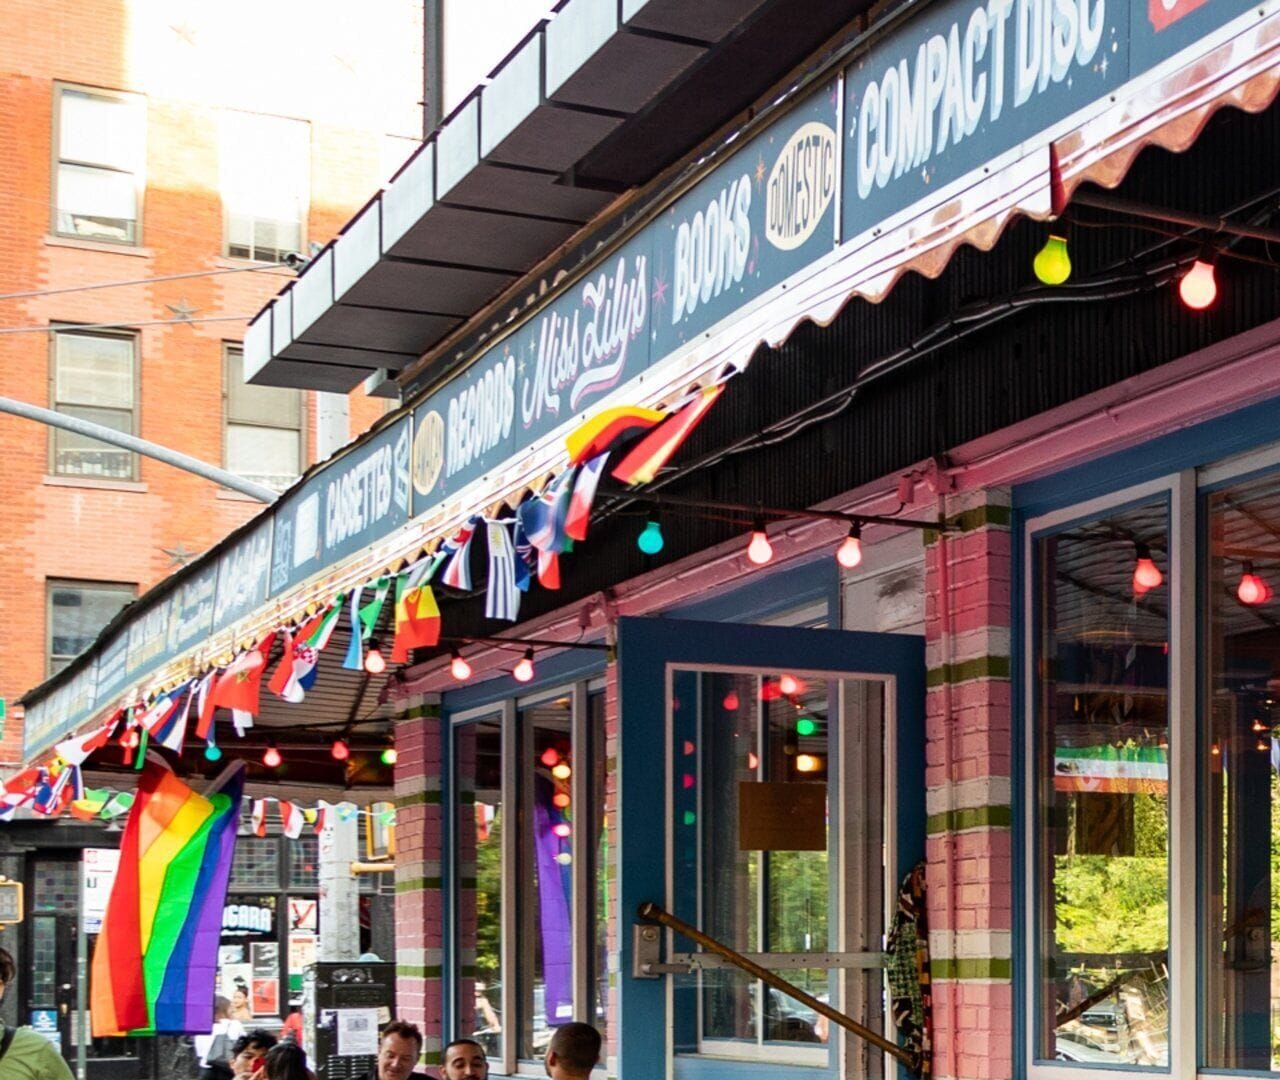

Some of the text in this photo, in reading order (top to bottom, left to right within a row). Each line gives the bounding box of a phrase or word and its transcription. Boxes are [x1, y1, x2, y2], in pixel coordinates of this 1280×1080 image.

[856, 0, 1106, 200] COMPACT DISC
[672, 173, 752, 324] BOOKS
[768, 134, 834, 241] DOMESTIC
[522, 254, 648, 429] Miss Lily's
[446, 355, 515, 478] RECORDS
[325, 444, 392, 549] CASSETTES
